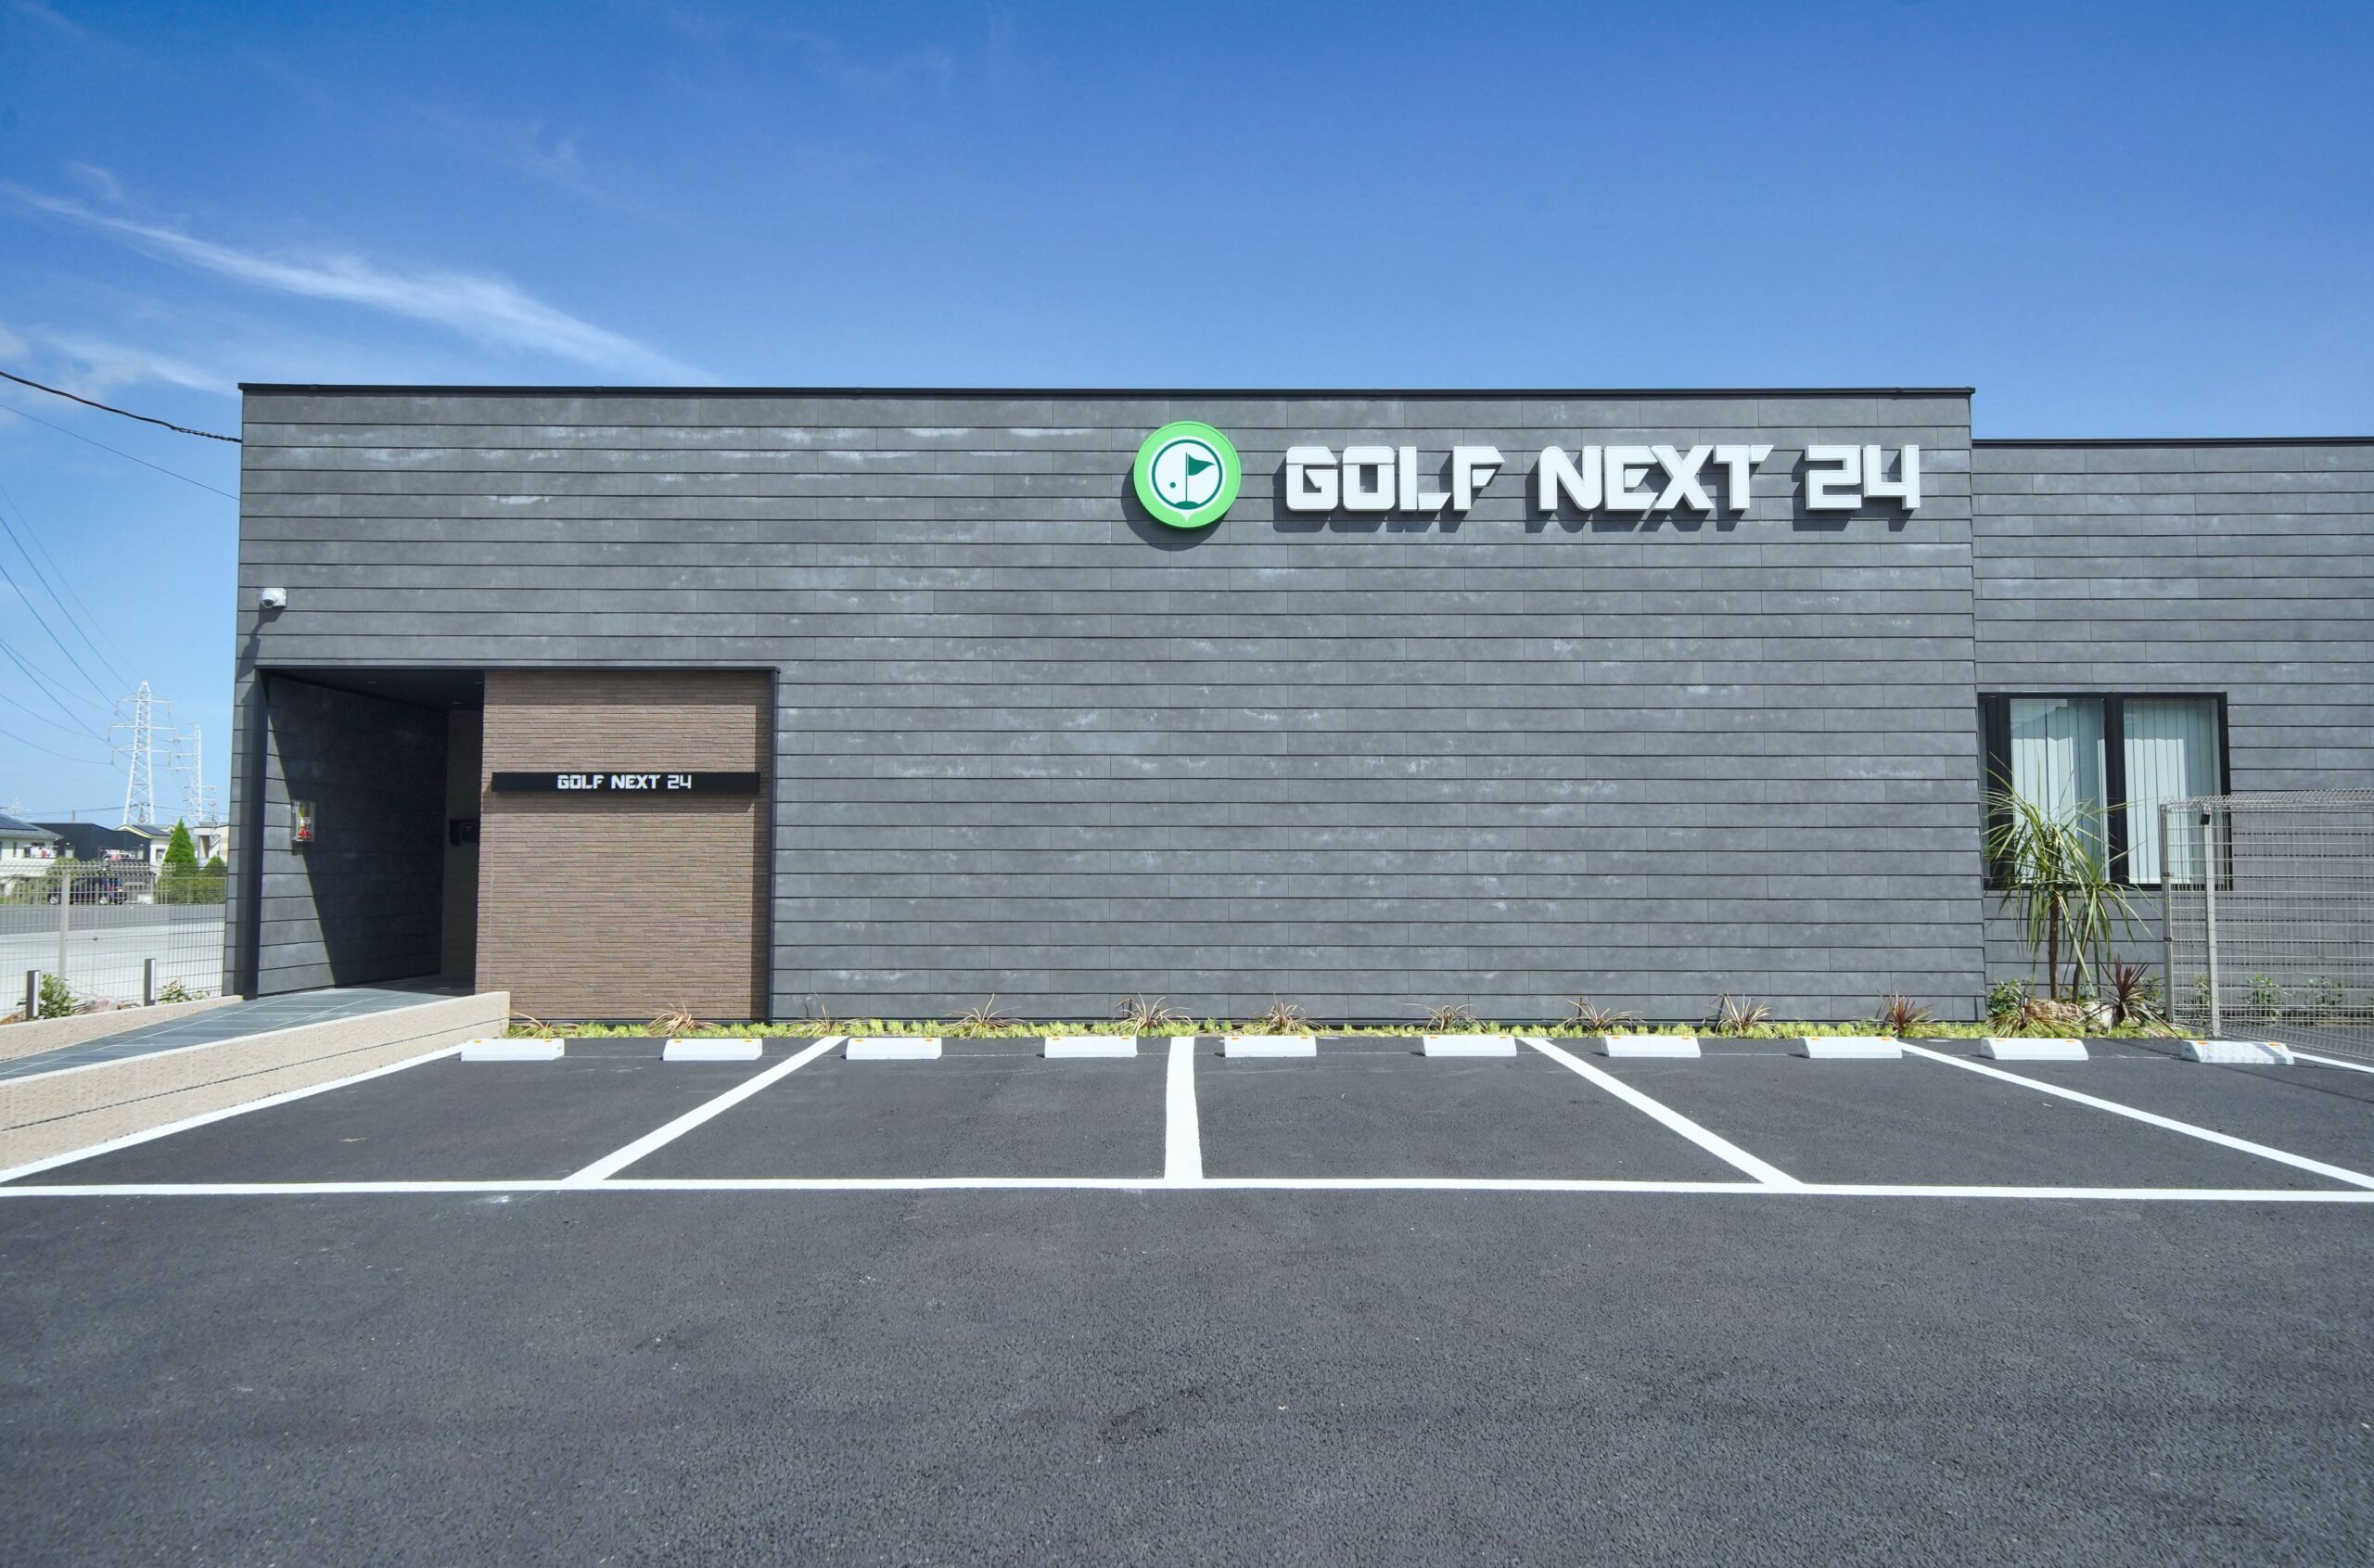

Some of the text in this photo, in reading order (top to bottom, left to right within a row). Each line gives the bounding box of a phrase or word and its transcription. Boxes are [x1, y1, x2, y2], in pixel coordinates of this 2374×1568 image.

[1285, 445, 1921, 511] GOLF NEXT 24
[556, 774, 692, 789] GOLF NEXT 24
